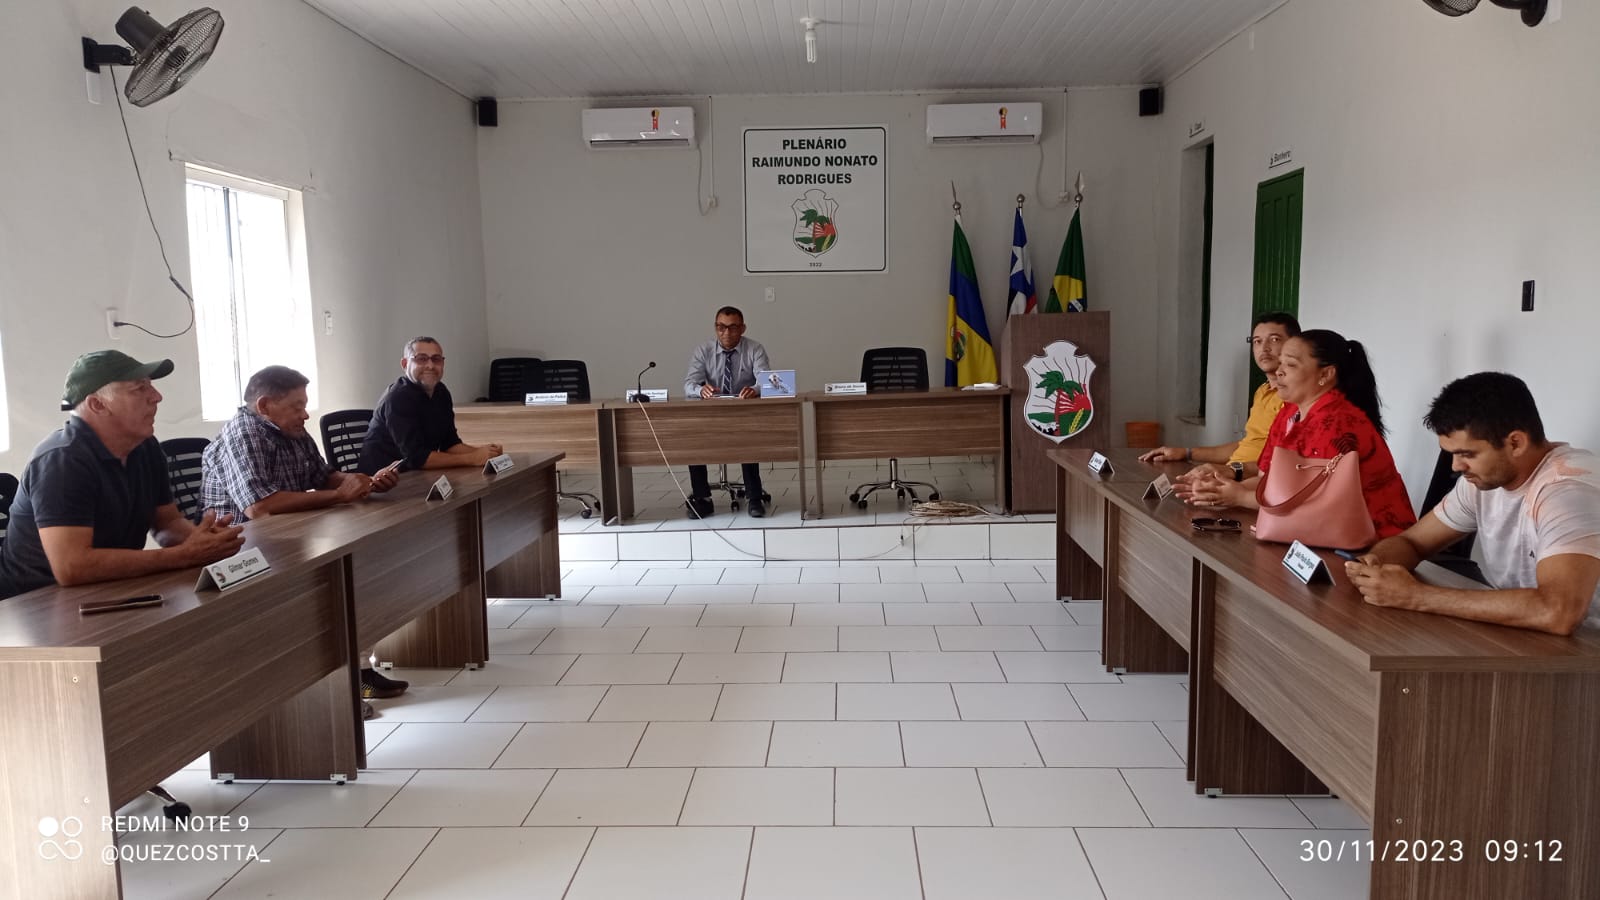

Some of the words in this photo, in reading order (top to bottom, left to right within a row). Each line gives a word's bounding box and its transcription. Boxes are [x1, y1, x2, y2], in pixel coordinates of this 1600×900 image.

[782, 136, 847, 150] PLENÁRIO
[752, 156, 821, 168] RAIMUNDO
[825, 155, 878, 167] NONATO
[778, 173, 852, 185] RODRIGUES
